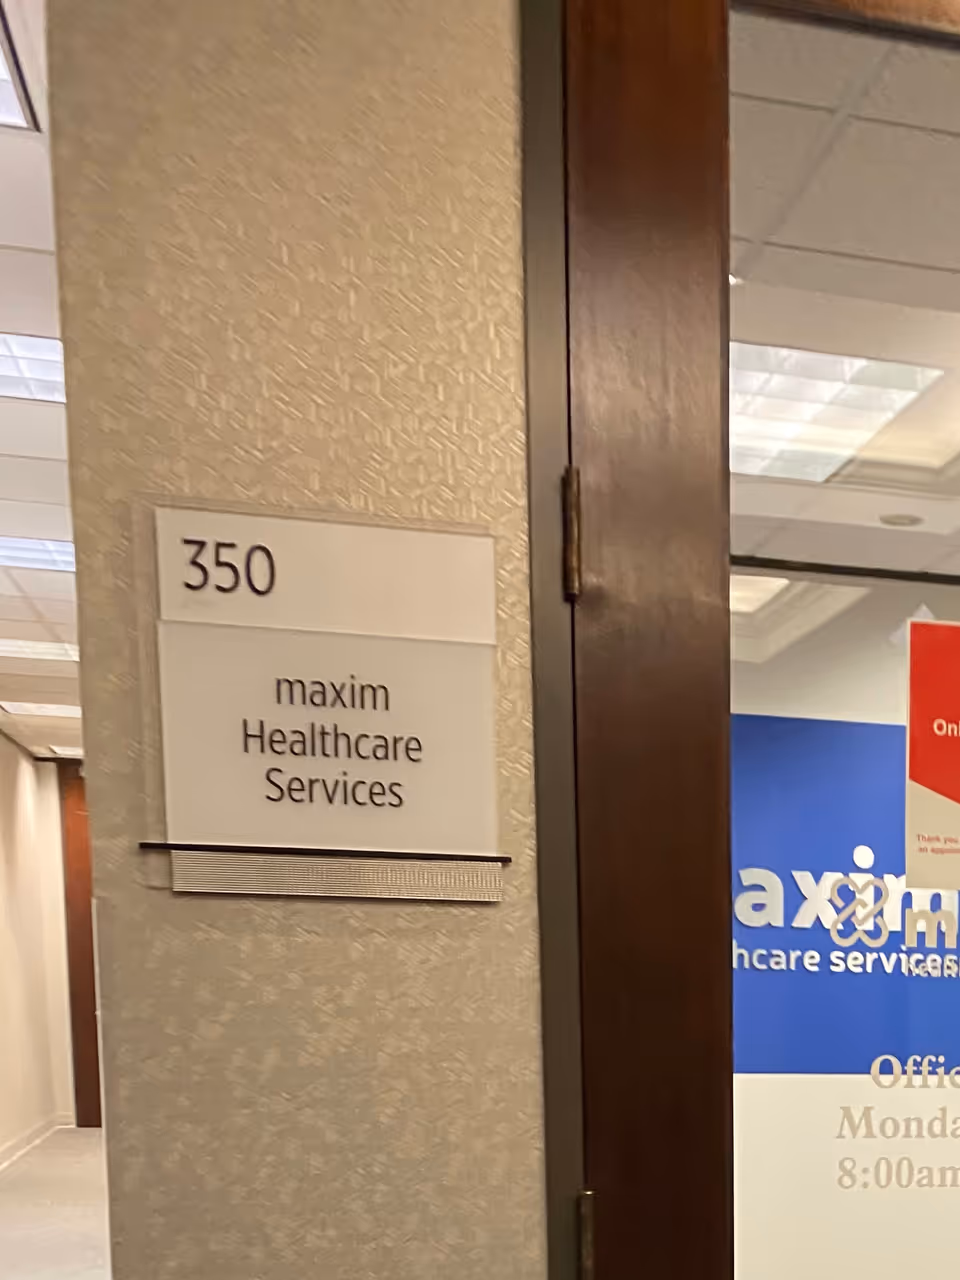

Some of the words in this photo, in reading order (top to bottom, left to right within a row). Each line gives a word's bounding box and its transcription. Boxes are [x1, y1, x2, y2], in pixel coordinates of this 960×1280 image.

[181, 537, 276, 597] 350
[275, 675, 390, 711] maxim
[242, 718, 423, 763] Healthcare
[265, 767, 404, 808] Services
